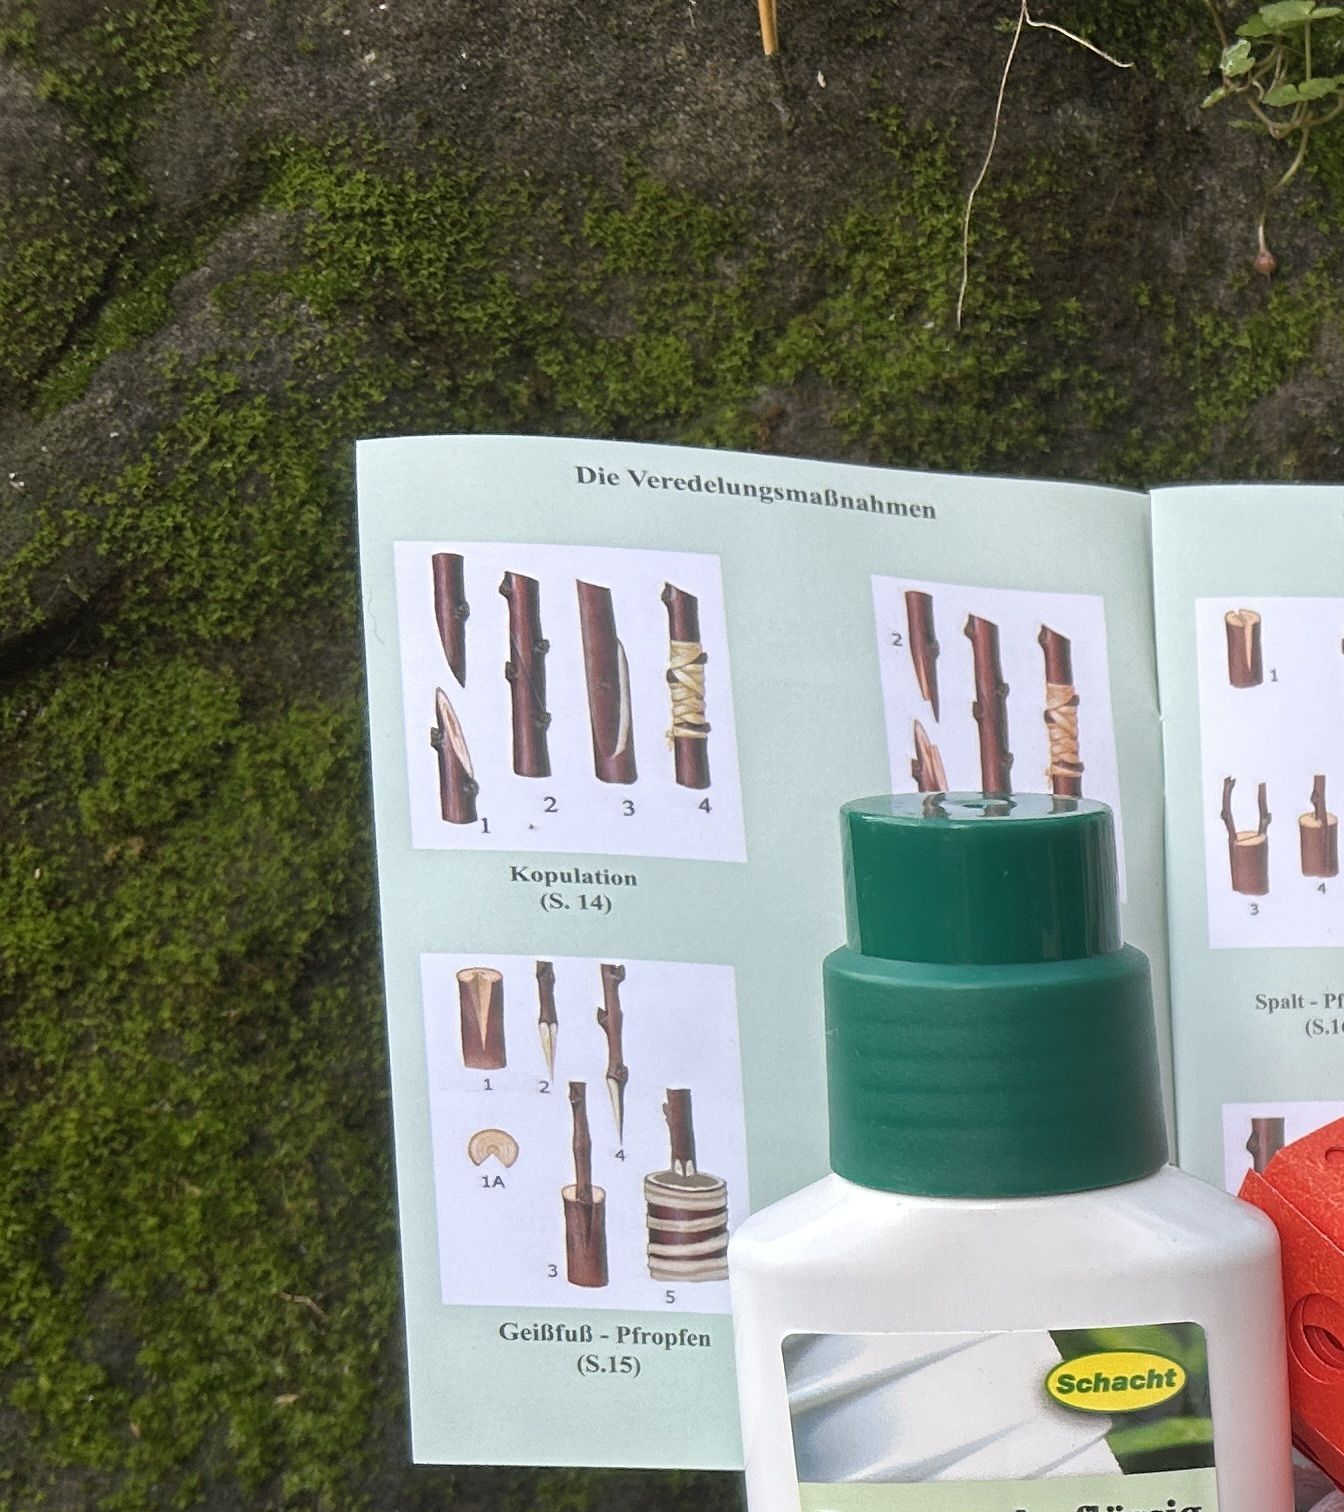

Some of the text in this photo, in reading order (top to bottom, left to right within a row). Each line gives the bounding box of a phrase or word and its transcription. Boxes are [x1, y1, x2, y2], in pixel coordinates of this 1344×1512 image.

[575, 465, 937, 521] Die Veredelungsmaßnahmen
[891, 633, 903, 647] 2
[1270, 669, 1278, 683] 1
[544, 797, 558, 813] 2
[622, 800, 635, 817] 3
[697, 797, 712, 814] 4
[481, 818, 490, 834] 1
[510, 866, 638, 892] Kopulation
[1317, 882, 1327, 895] 4
[540, 893, 612, 914] (S. 14)
[1250, 903, 1259, 917] 3
[1255, 993, 1304, 1012] Spalt
[483, 1079, 493, 1091] 1
[539, 1080, 550, 1094] 2
[614, 1149, 626, 1162] 4
[481, 1175, 506, 1190] 1A
[548, 1265, 558, 1279] 3
[665, 1290, 675, 1305] 5
[499, 1321, 712, 1350] Geißfuß Pfropfen
[577, 1354, 641, 1378] (S.15)
[1056, 1368, 1178, 1395] Schacht
